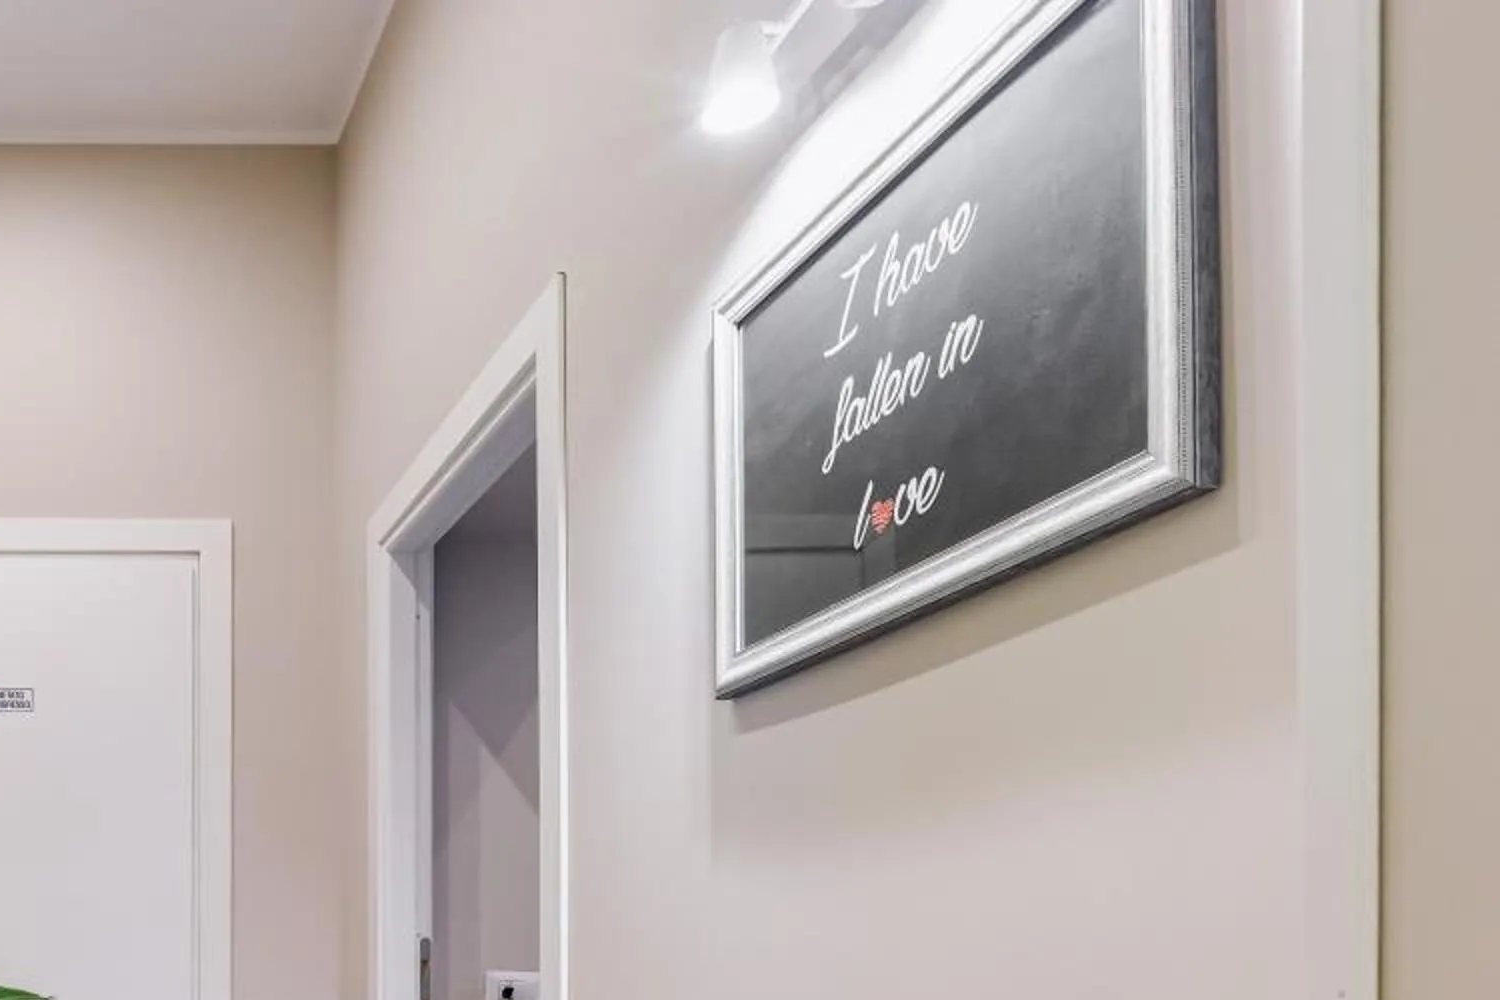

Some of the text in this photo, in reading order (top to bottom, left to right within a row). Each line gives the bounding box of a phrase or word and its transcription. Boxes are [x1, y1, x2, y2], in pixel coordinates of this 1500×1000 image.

[824, 201, 979, 358] I have
[821, 314, 984, 475] fallen in
